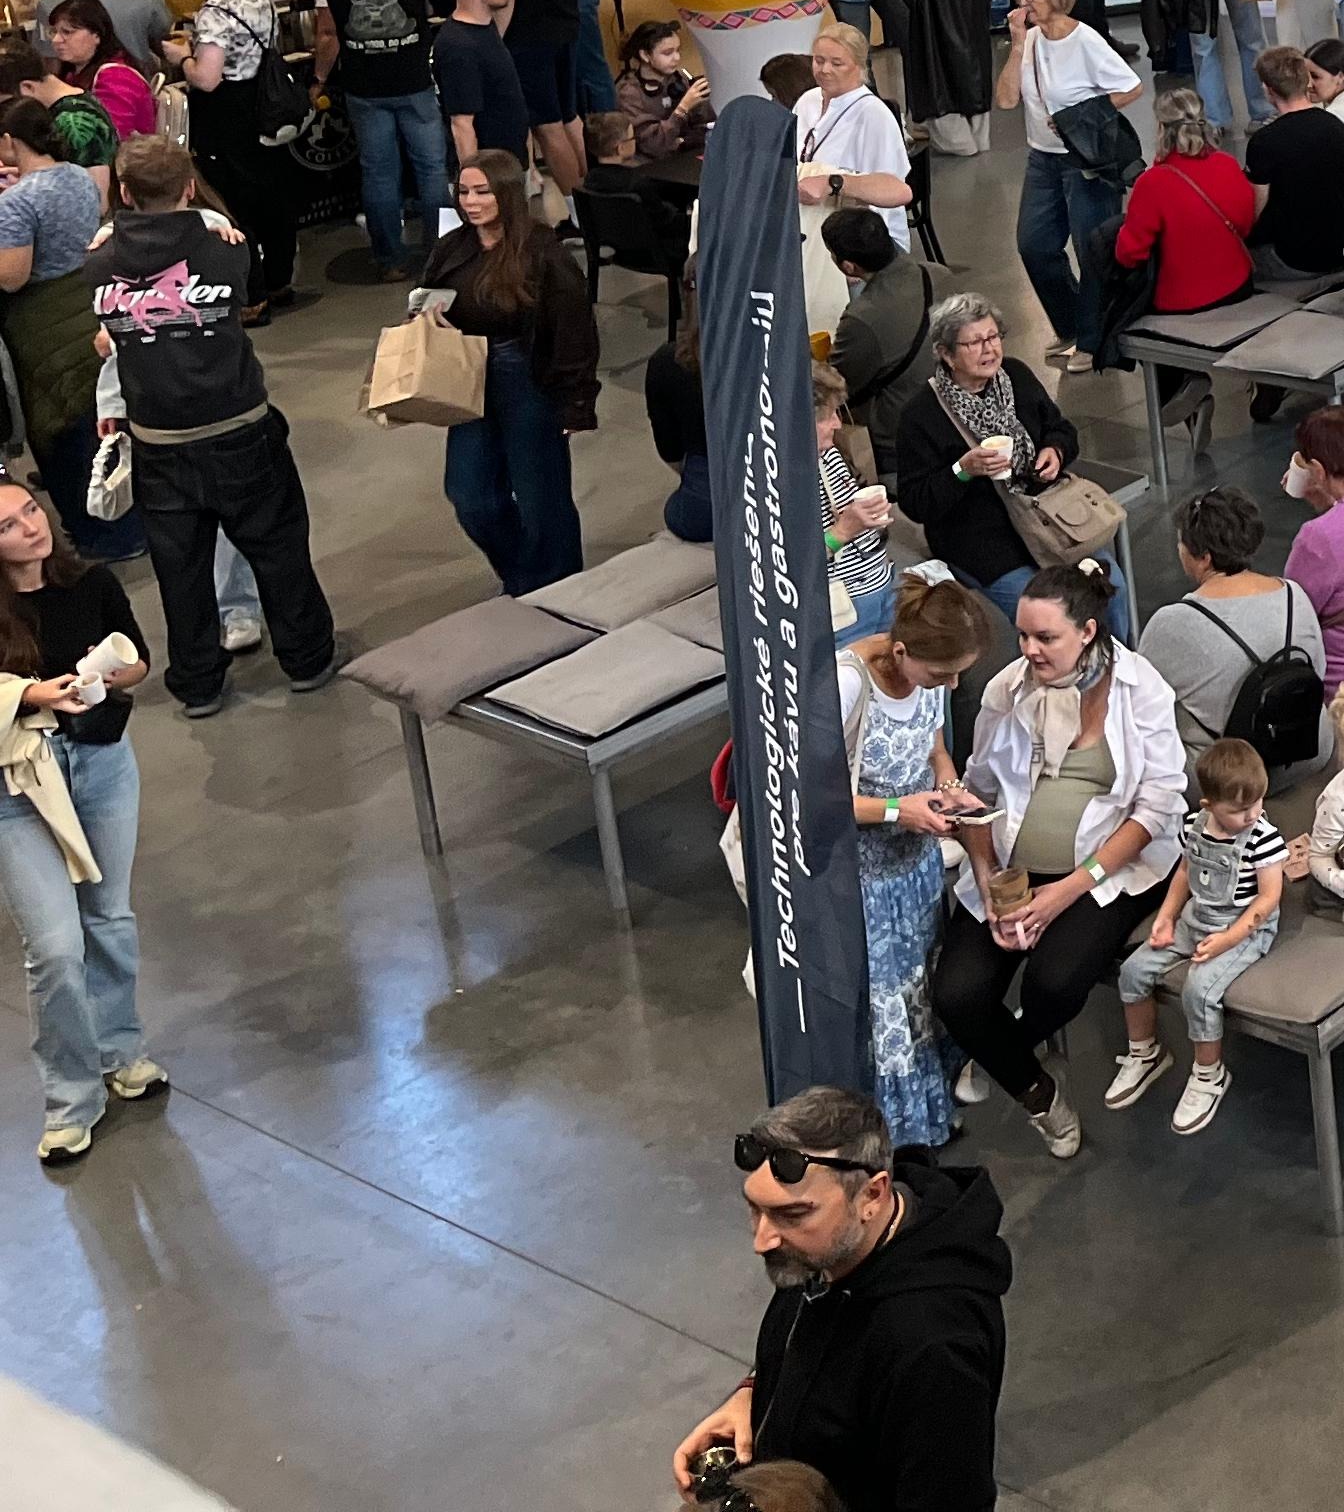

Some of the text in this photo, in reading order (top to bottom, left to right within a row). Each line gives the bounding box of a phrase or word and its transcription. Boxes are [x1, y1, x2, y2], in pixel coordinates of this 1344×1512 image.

[780, 619, 797, 651] a
[782, 666, 800, 780] kávu
[752, 635, 800, 969] Technologické
[793, 788, 812, 878] pre
